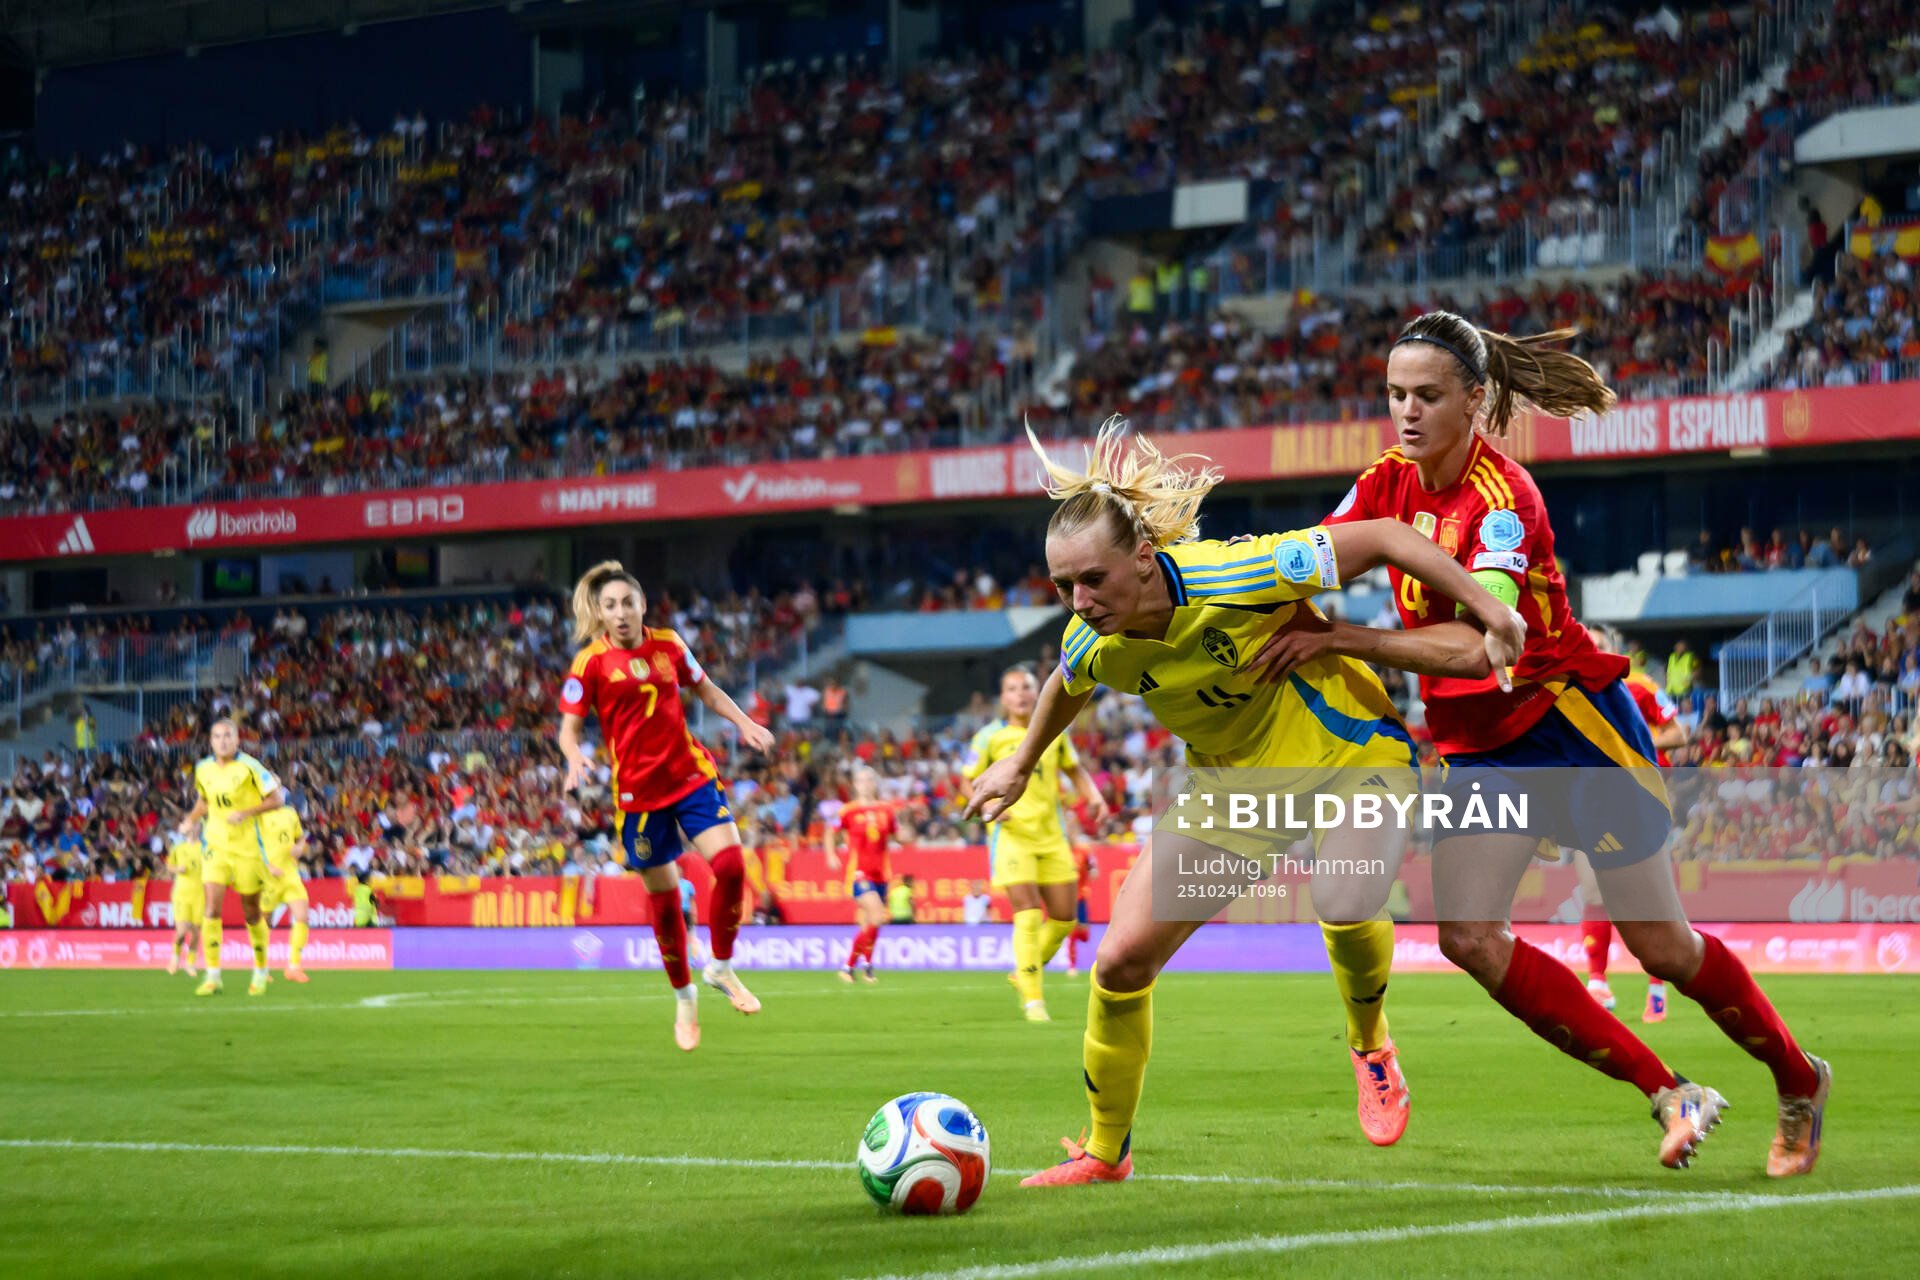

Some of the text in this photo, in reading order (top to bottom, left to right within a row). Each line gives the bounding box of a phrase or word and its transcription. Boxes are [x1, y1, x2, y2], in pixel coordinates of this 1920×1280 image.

[1569, 404, 1657, 456] VAMOS
[1668, 394, 1766, 449] ESPAÑA
[220, 507, 297, 537] Iberdrola
[1400, 573, 1430, 620] 4
[639, 683, 658, 718] 7
[215, 792, 233, 809] 16
